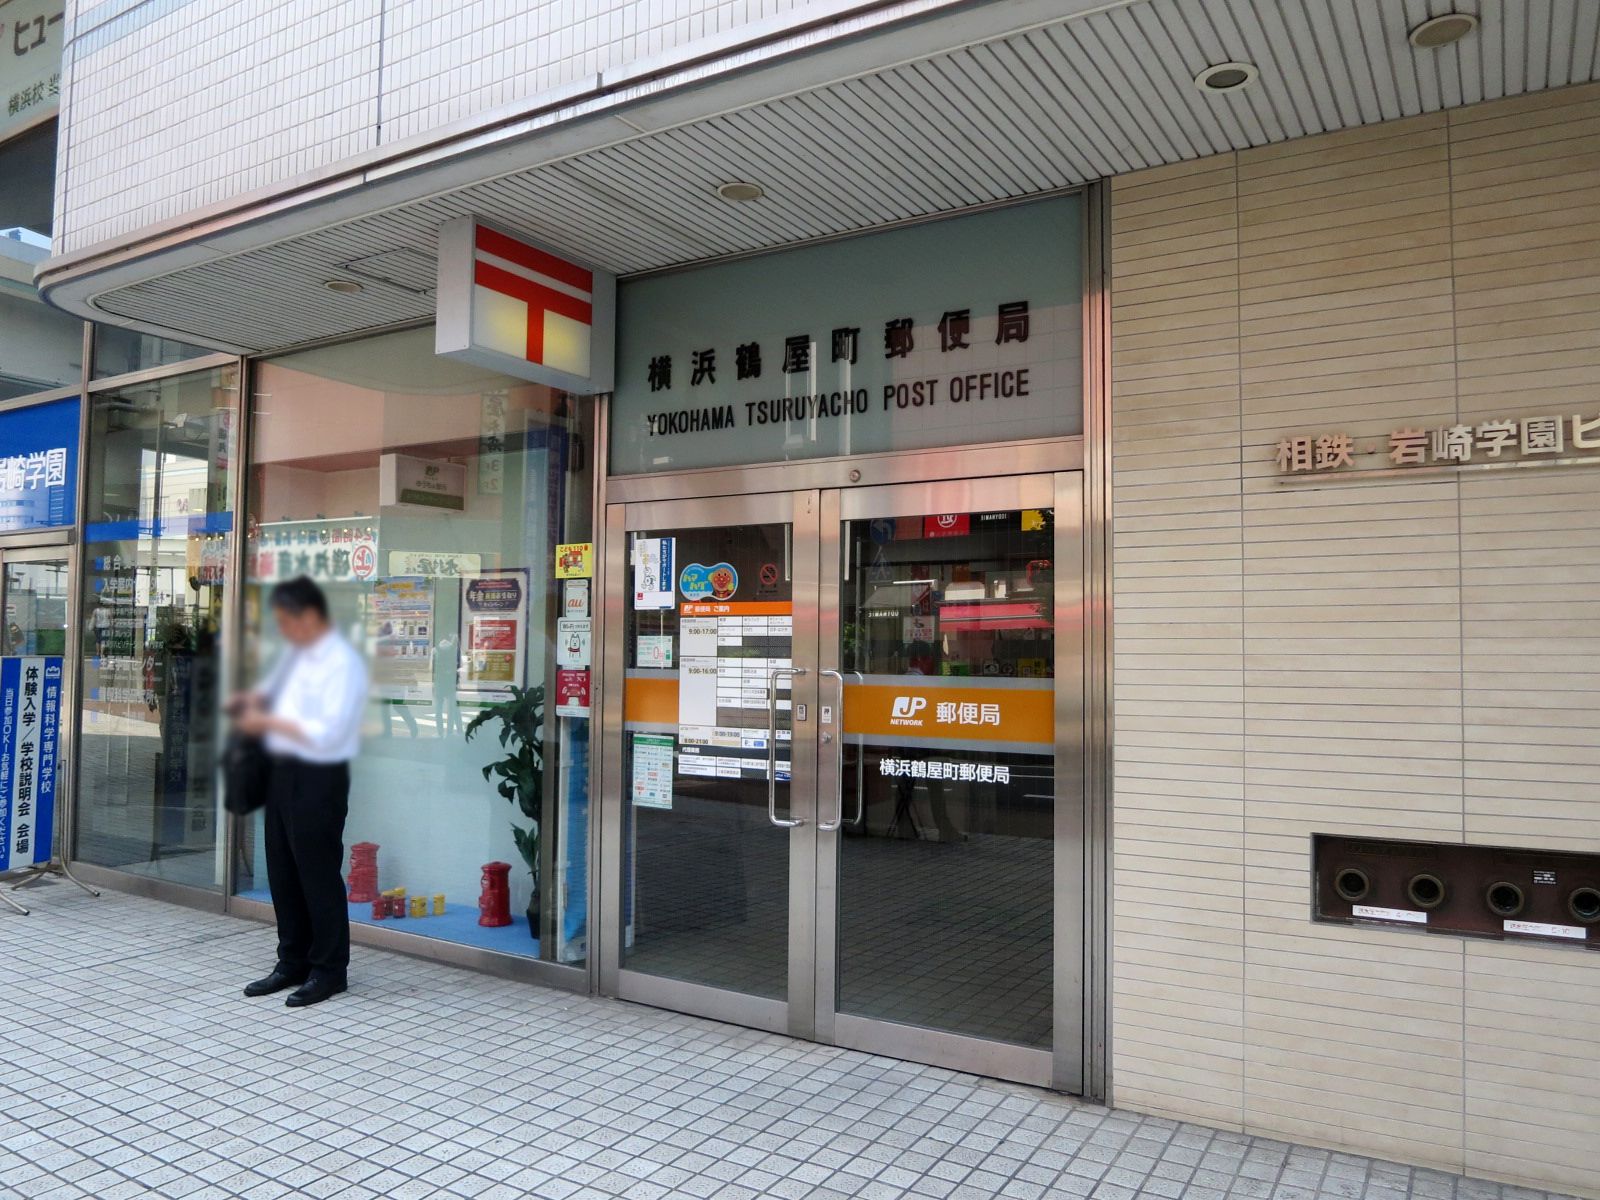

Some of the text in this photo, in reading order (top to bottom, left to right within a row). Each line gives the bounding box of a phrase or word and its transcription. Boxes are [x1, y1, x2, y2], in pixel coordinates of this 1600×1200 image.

[648, 301, 1029, 392] 横浜鶴屋町郵便局
[647, 368, 1029, 436] YOKOHAMA TSURUYACHO POST OFFICE
[568, 598, 585, 608] au
[890, 719, 923, 727] NETWORK
[936, 702, 1000, 726] 郵便局
[879, 758, 1011, 785] 横浜鶴屋町郵便局
